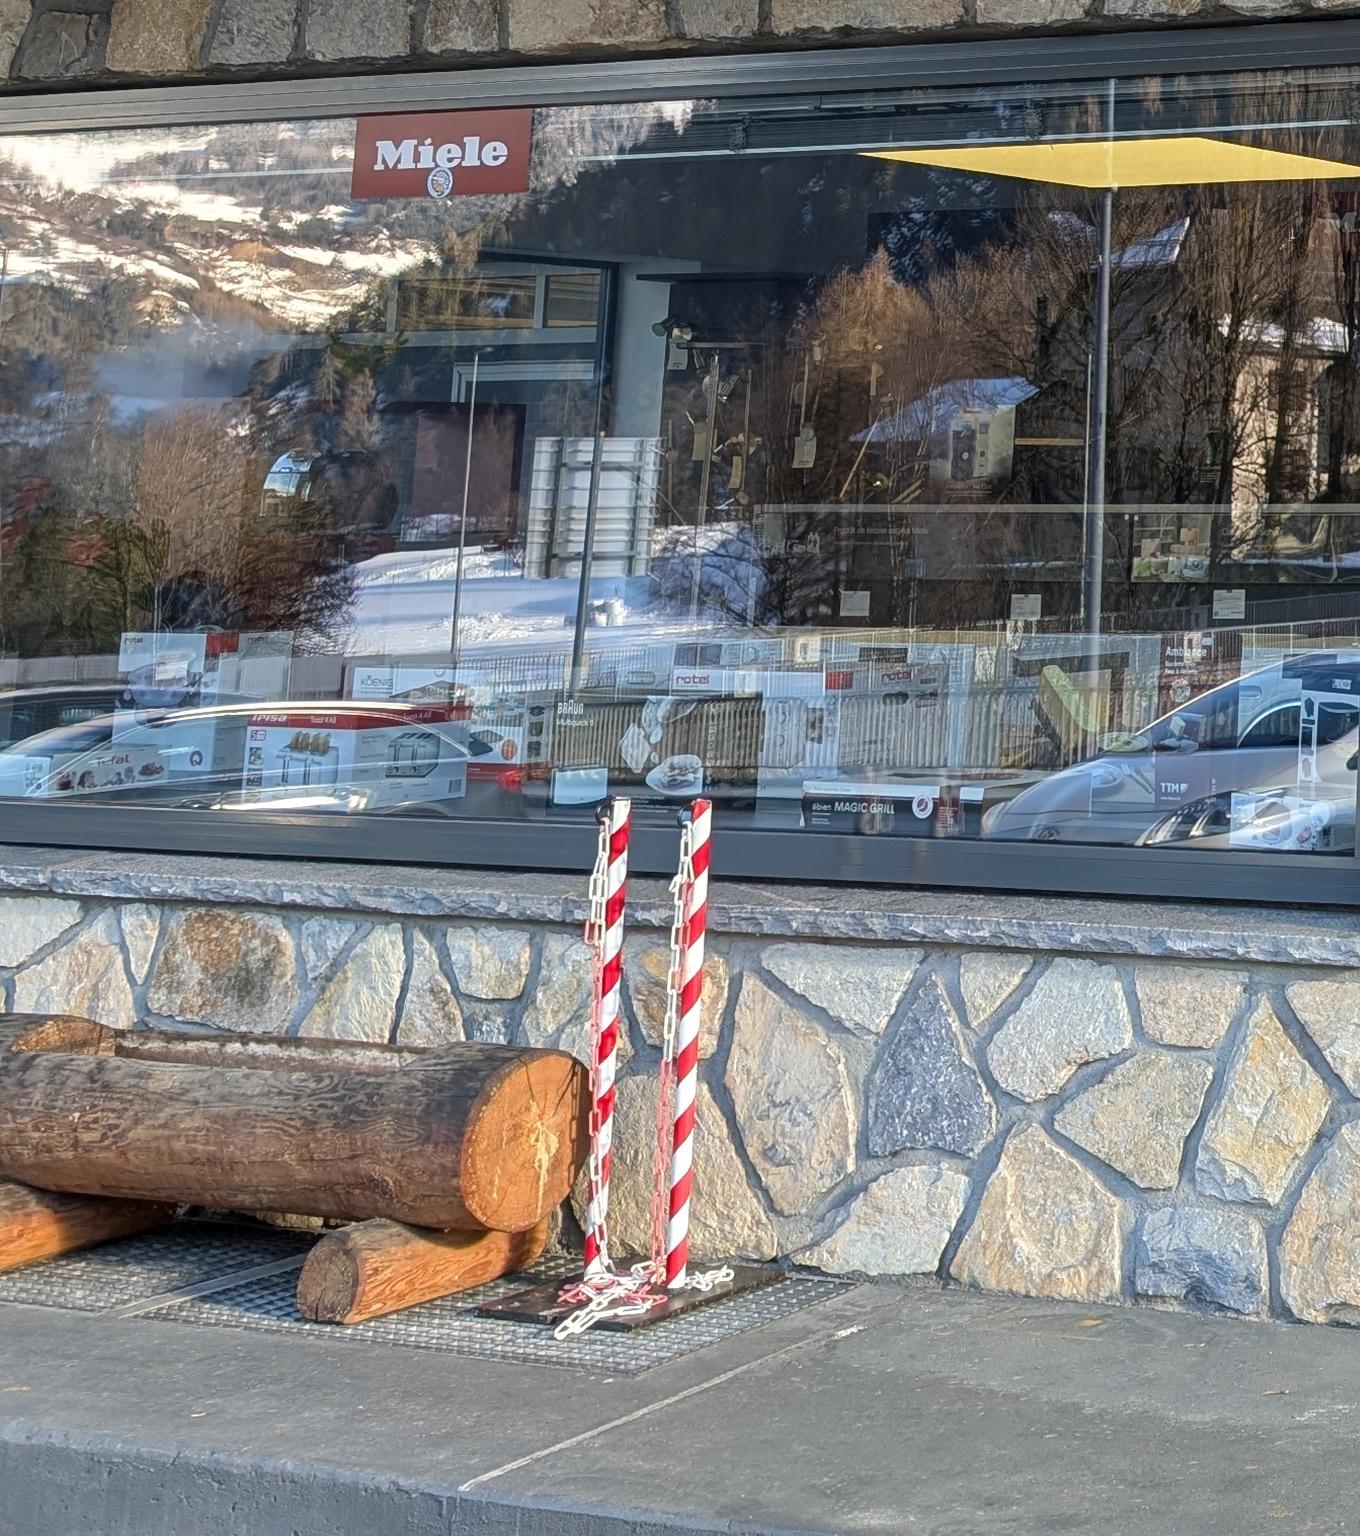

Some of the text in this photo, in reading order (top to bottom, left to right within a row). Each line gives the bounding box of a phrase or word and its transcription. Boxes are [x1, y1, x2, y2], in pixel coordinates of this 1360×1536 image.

[373, 136, 509, 171] Miele
[676, 674, 710, 685] rotel
[557, 700, 584, 715] BRAUN
[1160, 782, 1180, 793] TTM
[834, 801, 868, 812] MAGIC
[869, 803, 895, 814] GRILL
